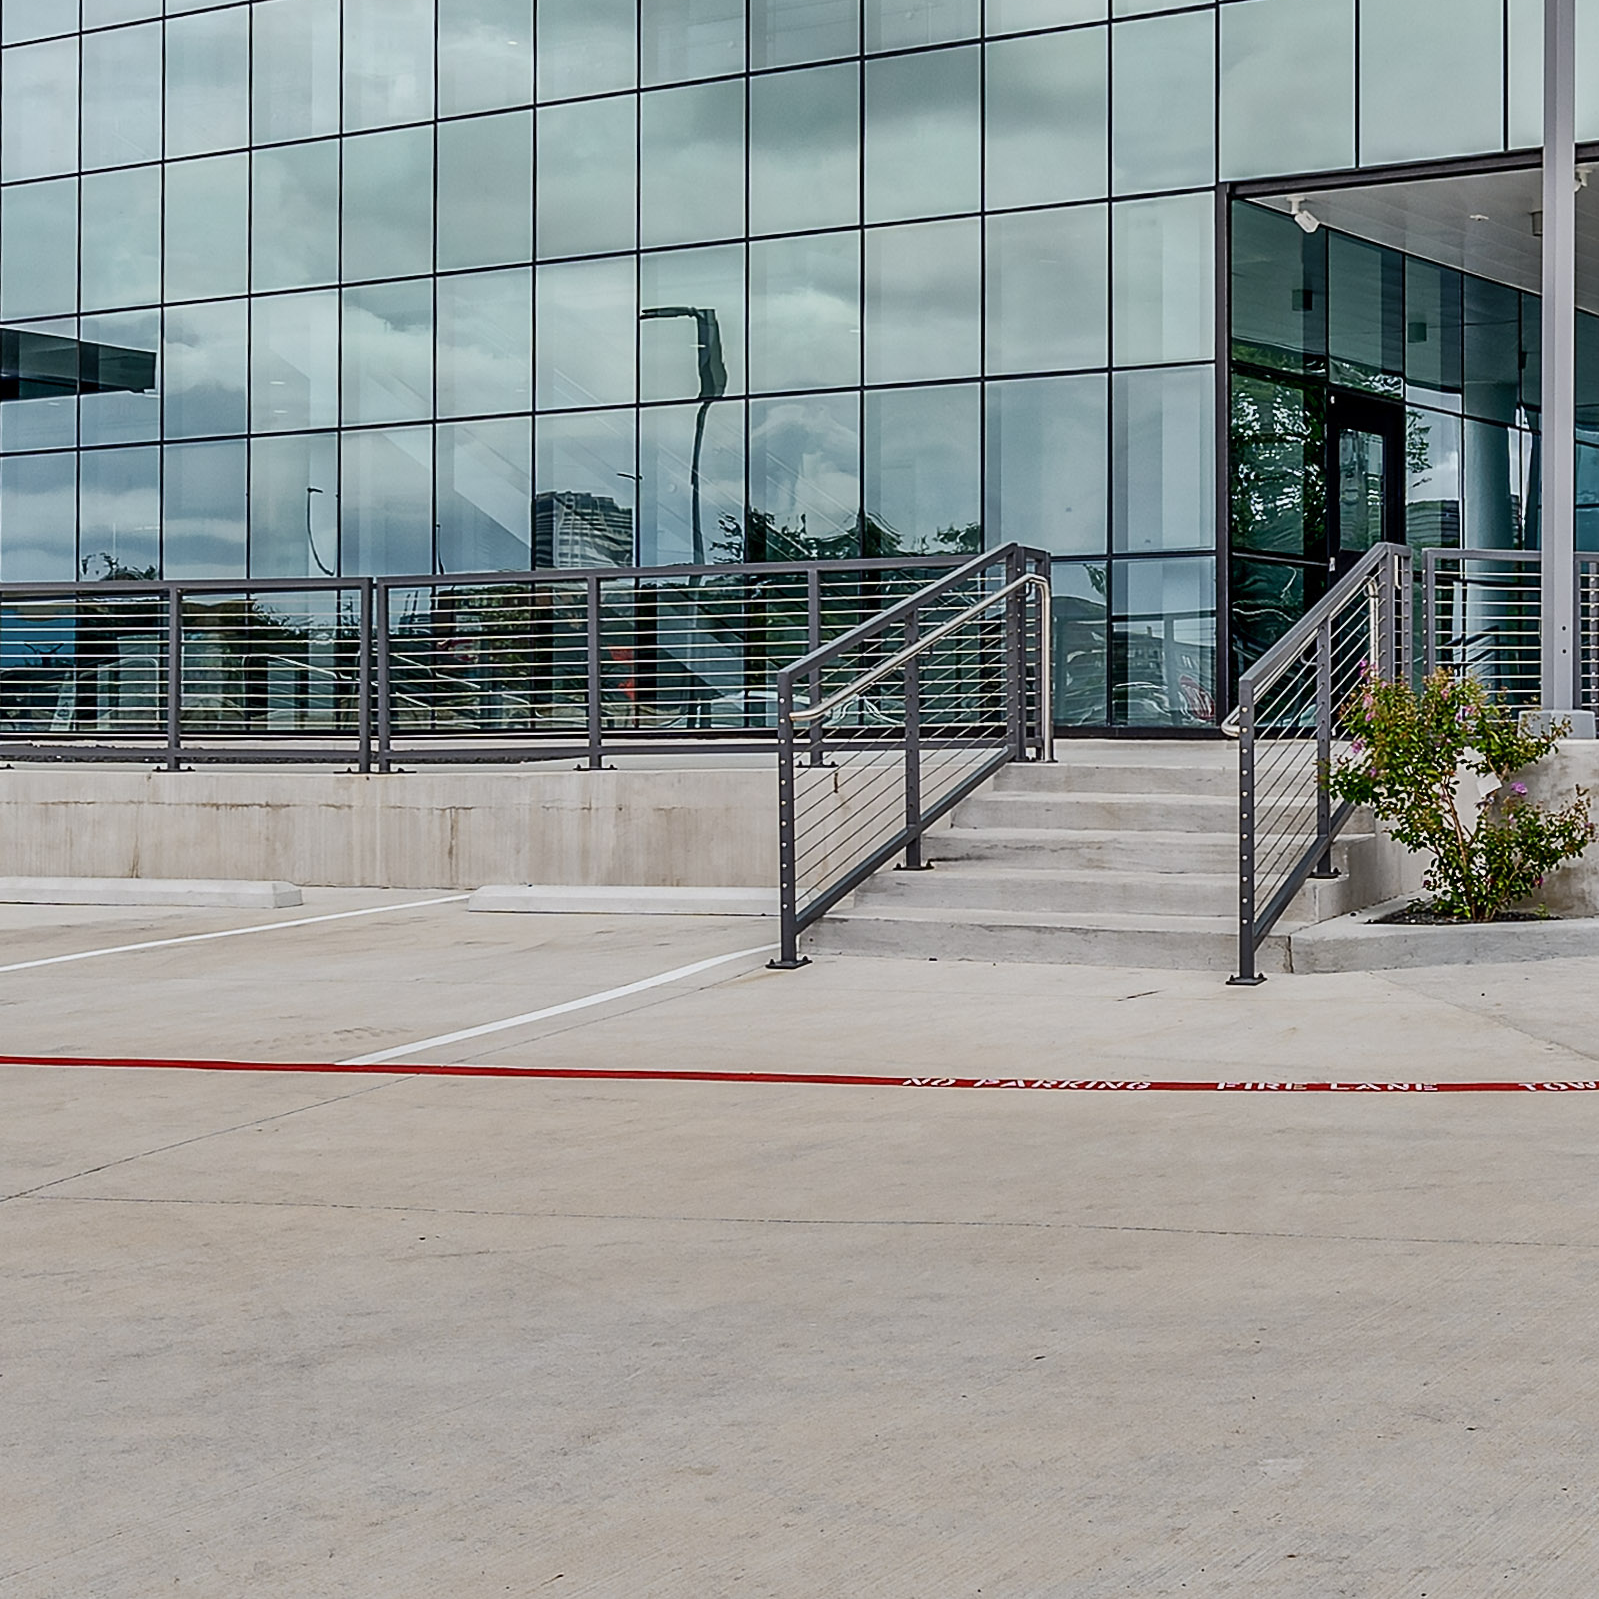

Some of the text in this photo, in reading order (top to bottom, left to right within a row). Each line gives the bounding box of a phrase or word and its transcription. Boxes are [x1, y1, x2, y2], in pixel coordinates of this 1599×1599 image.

[902, 1078, 1152, 1090] NO PARKING
[1216, 1082, 1439, 1091] FIRE LANE
[1517, 1081, 1597, 1091] TOW
